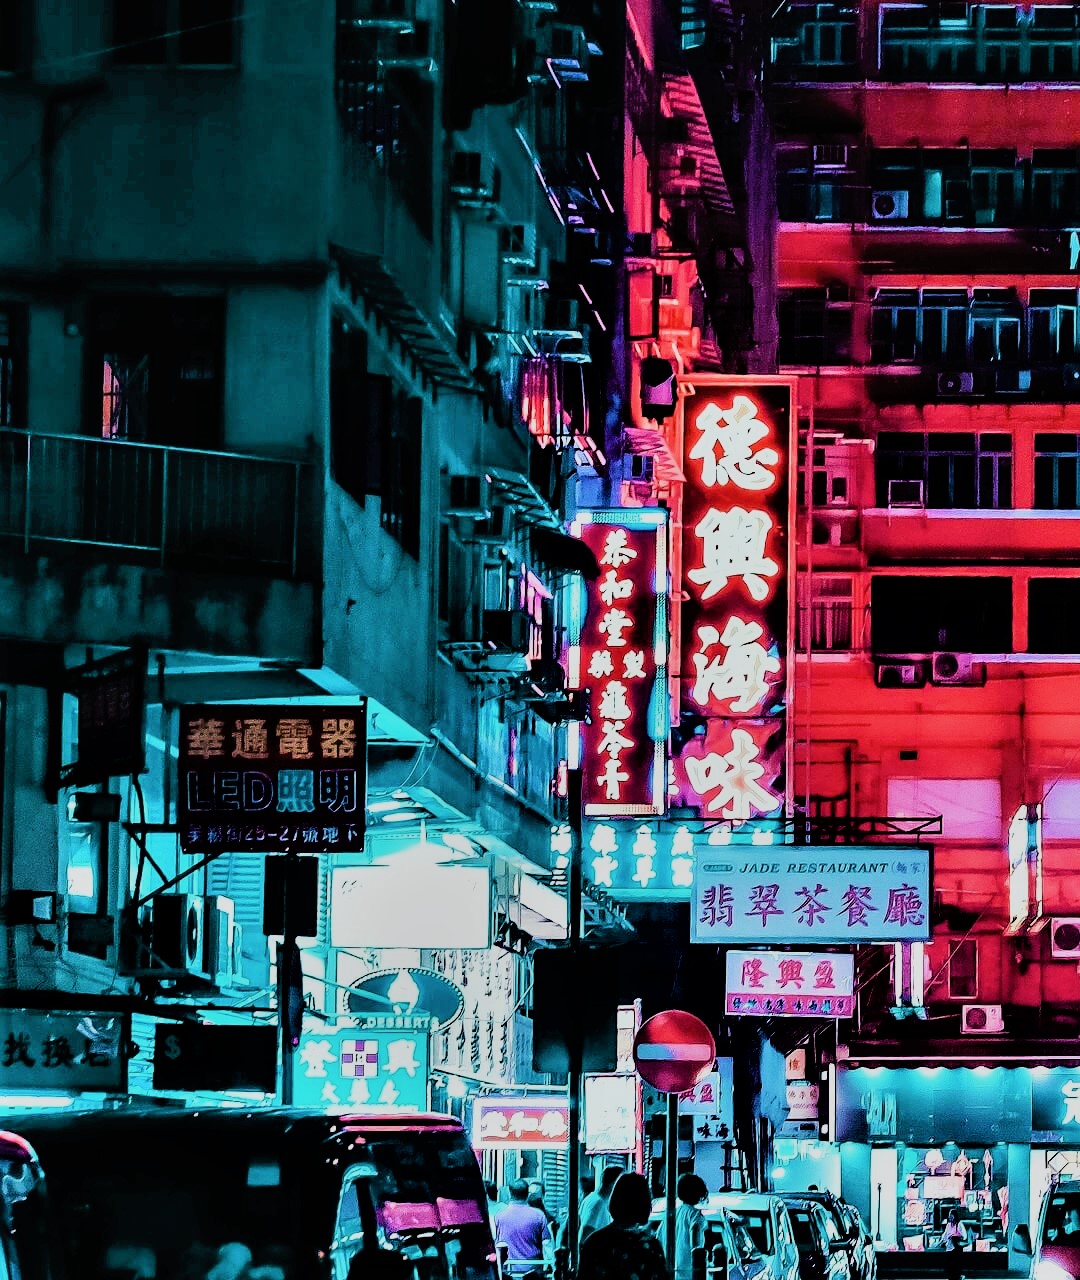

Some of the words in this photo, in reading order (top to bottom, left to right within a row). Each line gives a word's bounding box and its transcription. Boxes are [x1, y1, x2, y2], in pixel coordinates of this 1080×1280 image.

[684, 394, 781, 819] 德興海味
[186, 717, 358, 760] 華通電器
[739, 862, 780, 874] JADE
[786, 862, 889, 874] RESTAURANT
[699, 882, 926, 928] 翡翠茶餐廳
[740, 957, 837, 990] 隆興盈
